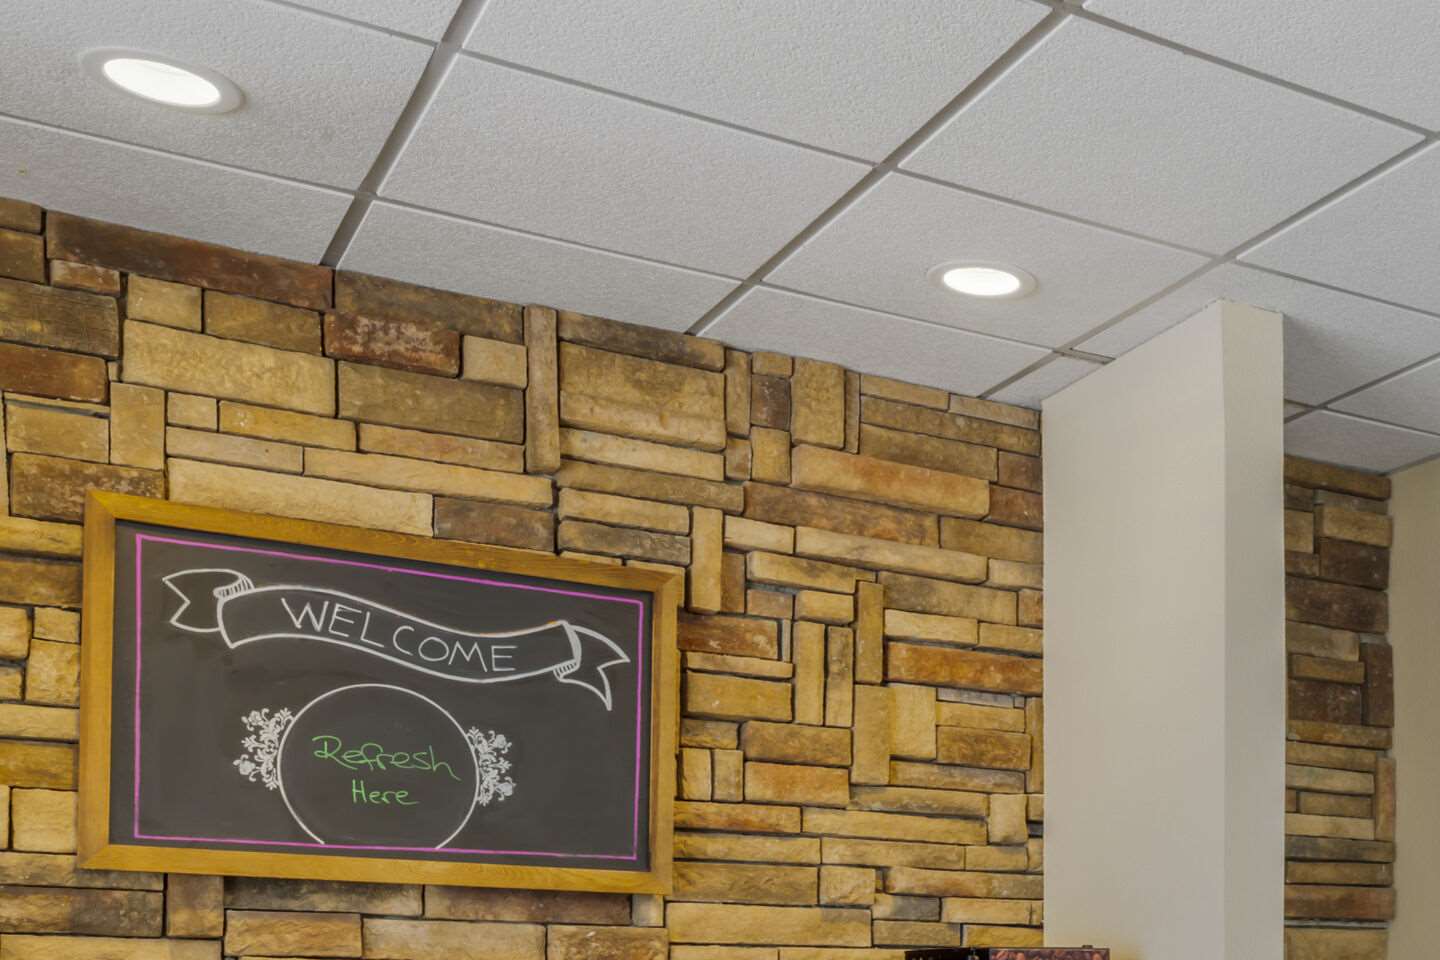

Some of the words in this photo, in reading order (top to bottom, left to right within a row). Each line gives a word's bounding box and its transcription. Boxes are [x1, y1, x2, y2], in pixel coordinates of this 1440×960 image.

[279, 597, 519, 673] WELCOME
[311, 734, 464, 781] Refresh
[350, 778, 421, 807] Here
